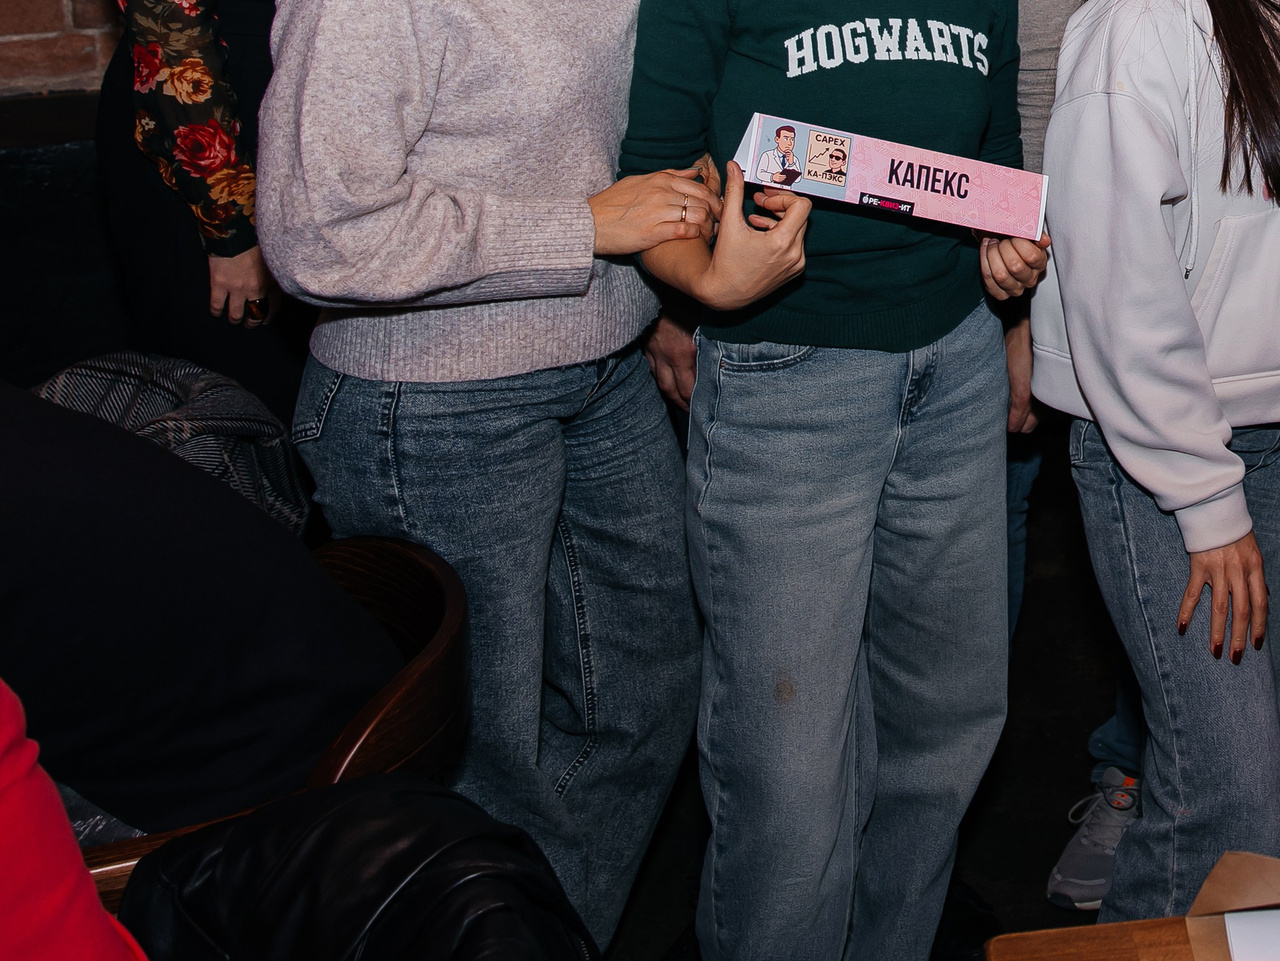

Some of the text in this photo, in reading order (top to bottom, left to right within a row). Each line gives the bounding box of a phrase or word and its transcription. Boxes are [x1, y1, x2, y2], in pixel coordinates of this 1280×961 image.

[784, 17, 989, 78] HOGWARTS
[815, 134, 846, 147] CAPEX
[807, 169, 843, 183] КА-ПЭКС
[887, 158, 970, 199] КАПЕКС
